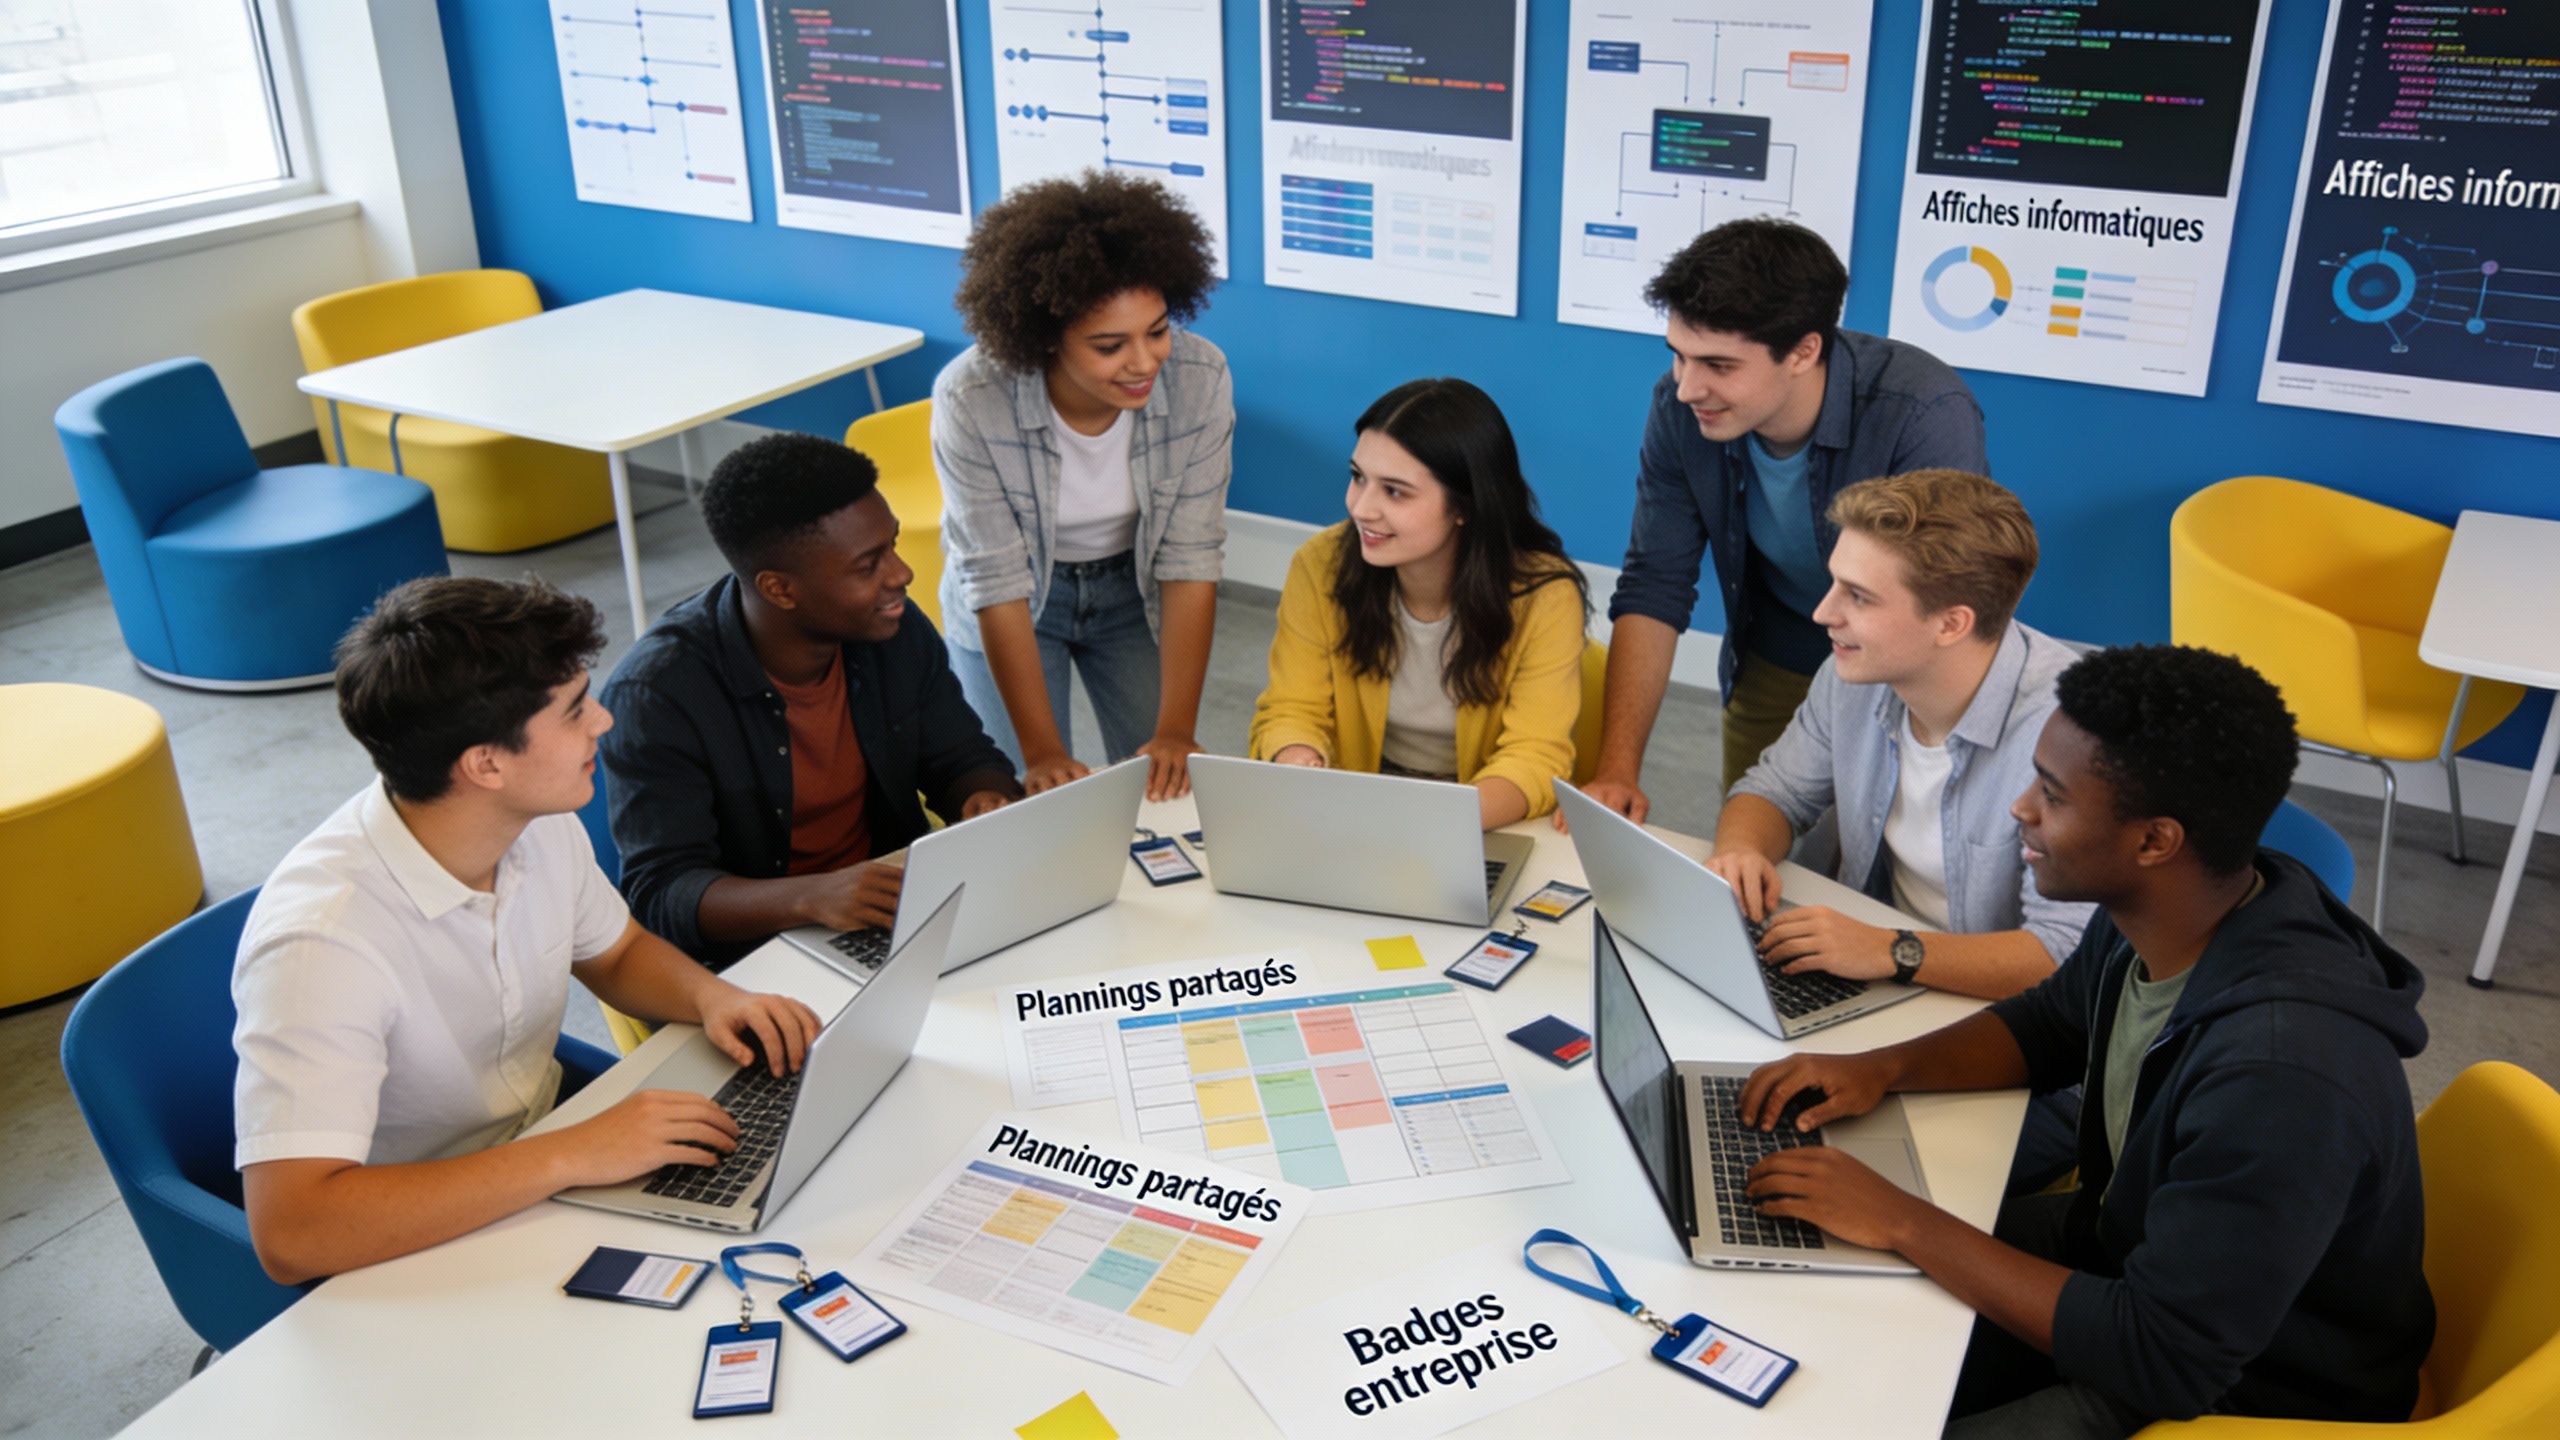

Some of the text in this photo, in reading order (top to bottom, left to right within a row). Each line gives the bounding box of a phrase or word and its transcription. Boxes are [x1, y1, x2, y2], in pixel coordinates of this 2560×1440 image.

[2324, 159, 2455, 202] Affiches
[1922, 190, 2204, 247] Affiches informatiques
[1016, 981, 1162, 1022] Plannings
[1169, 958, 1298, 1007] partagés
[988, 1125, 1282, 1222] Plannings partagés
[1343, 1294, 1505, 1366] Badges
[1344, 1323, 1558, 1416] entreprise
